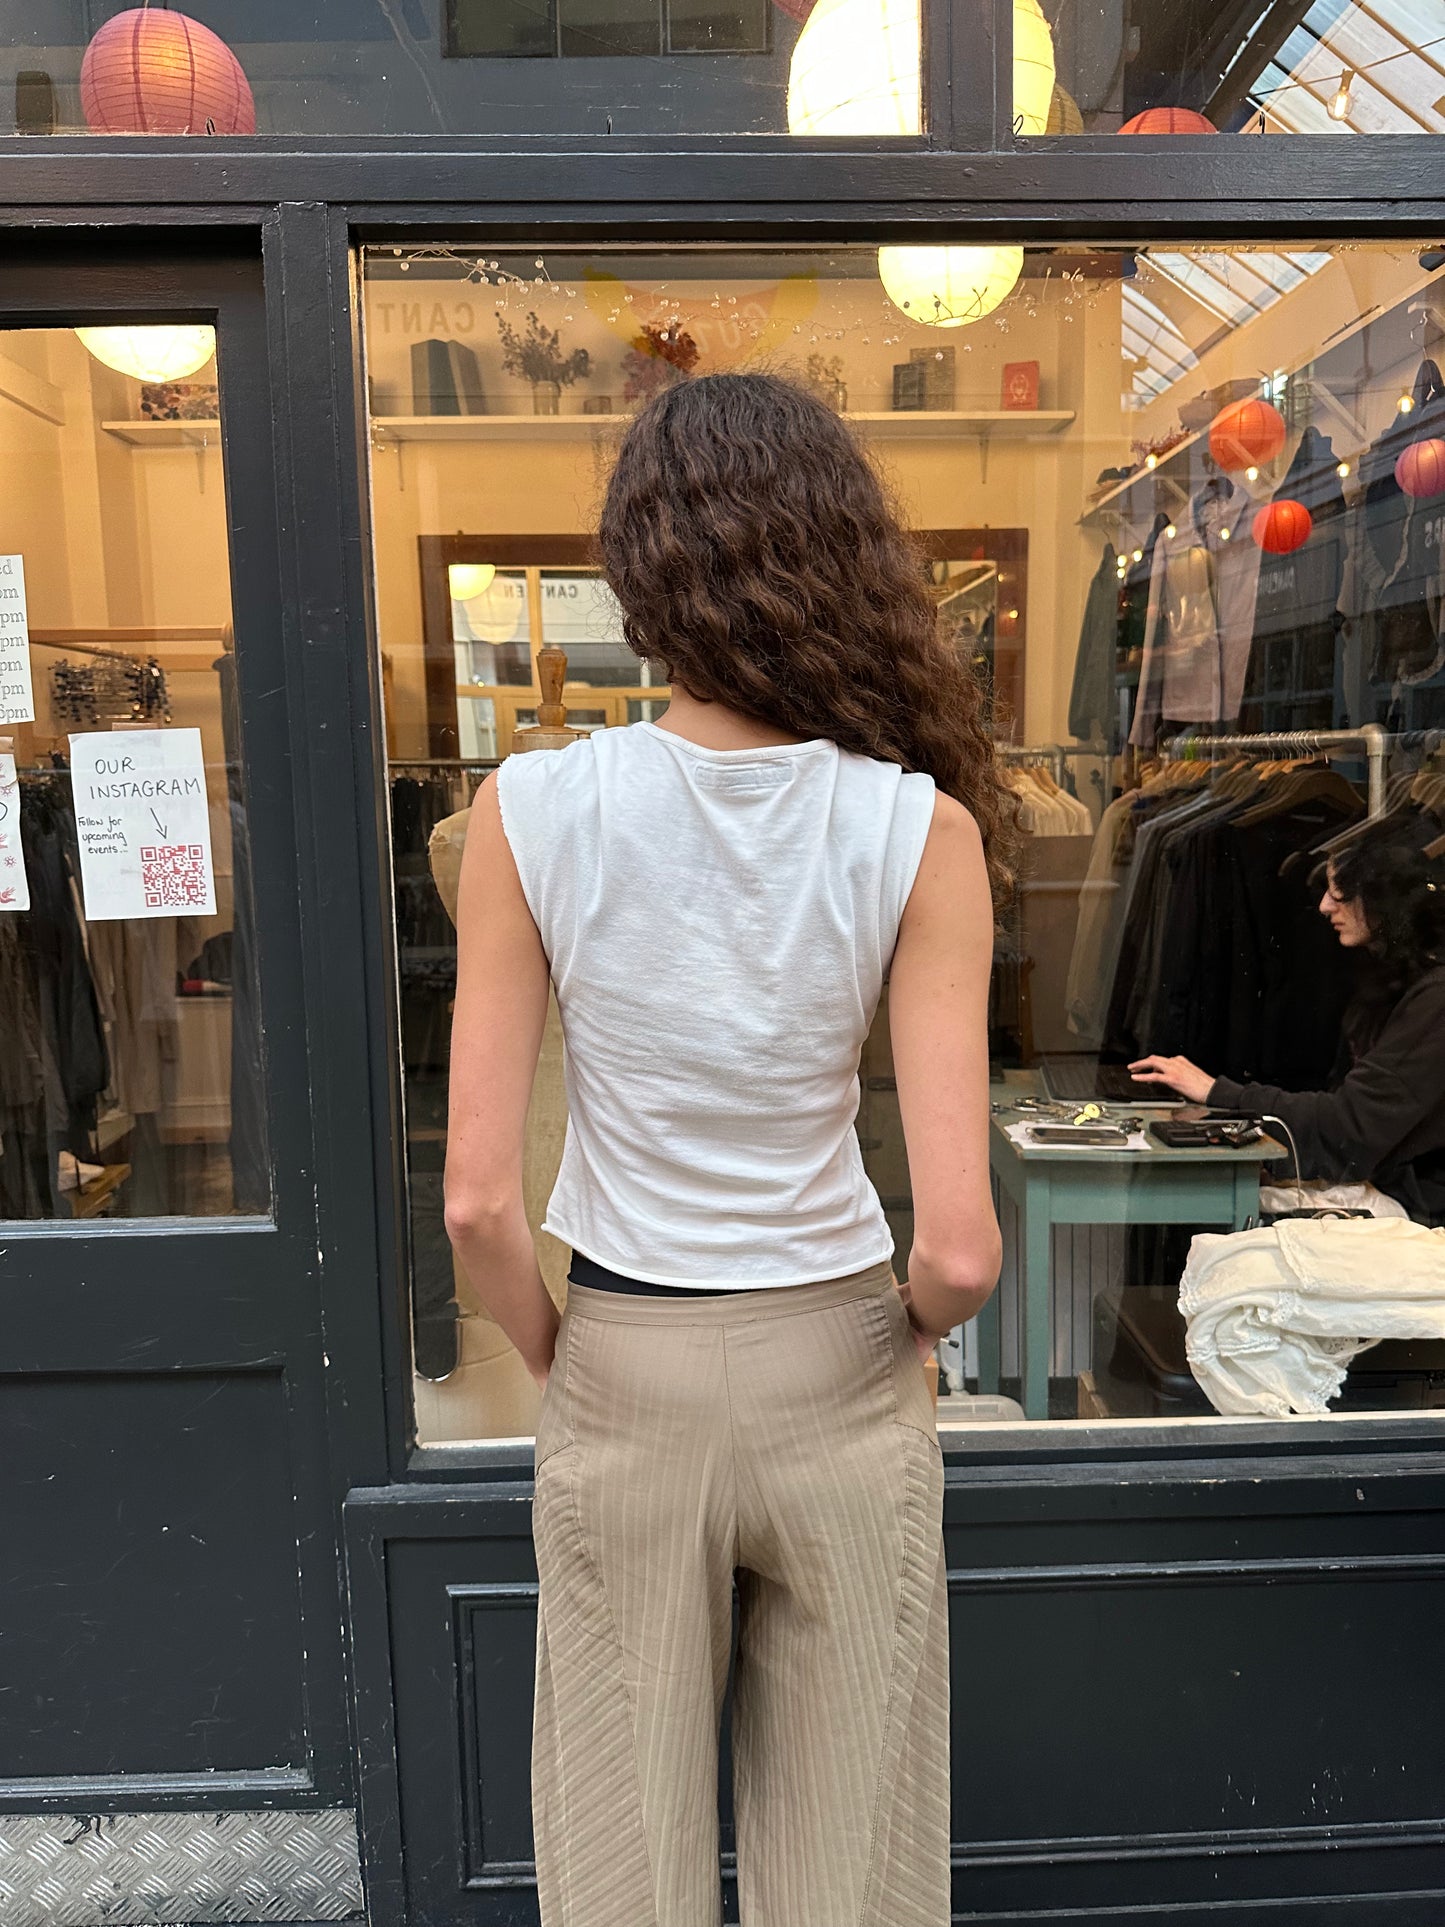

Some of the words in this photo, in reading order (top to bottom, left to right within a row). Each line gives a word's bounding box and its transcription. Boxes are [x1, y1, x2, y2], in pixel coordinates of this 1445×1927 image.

[0, 682, 24, 700] pm
[95, 757, 136, 775] OUR
[90, 778, 201, 800] INSTAGRAM
[78, 816, 104, 827] Follow
[107, 815, 122, 833] for
[82, 832, 128, 847] upcoming
